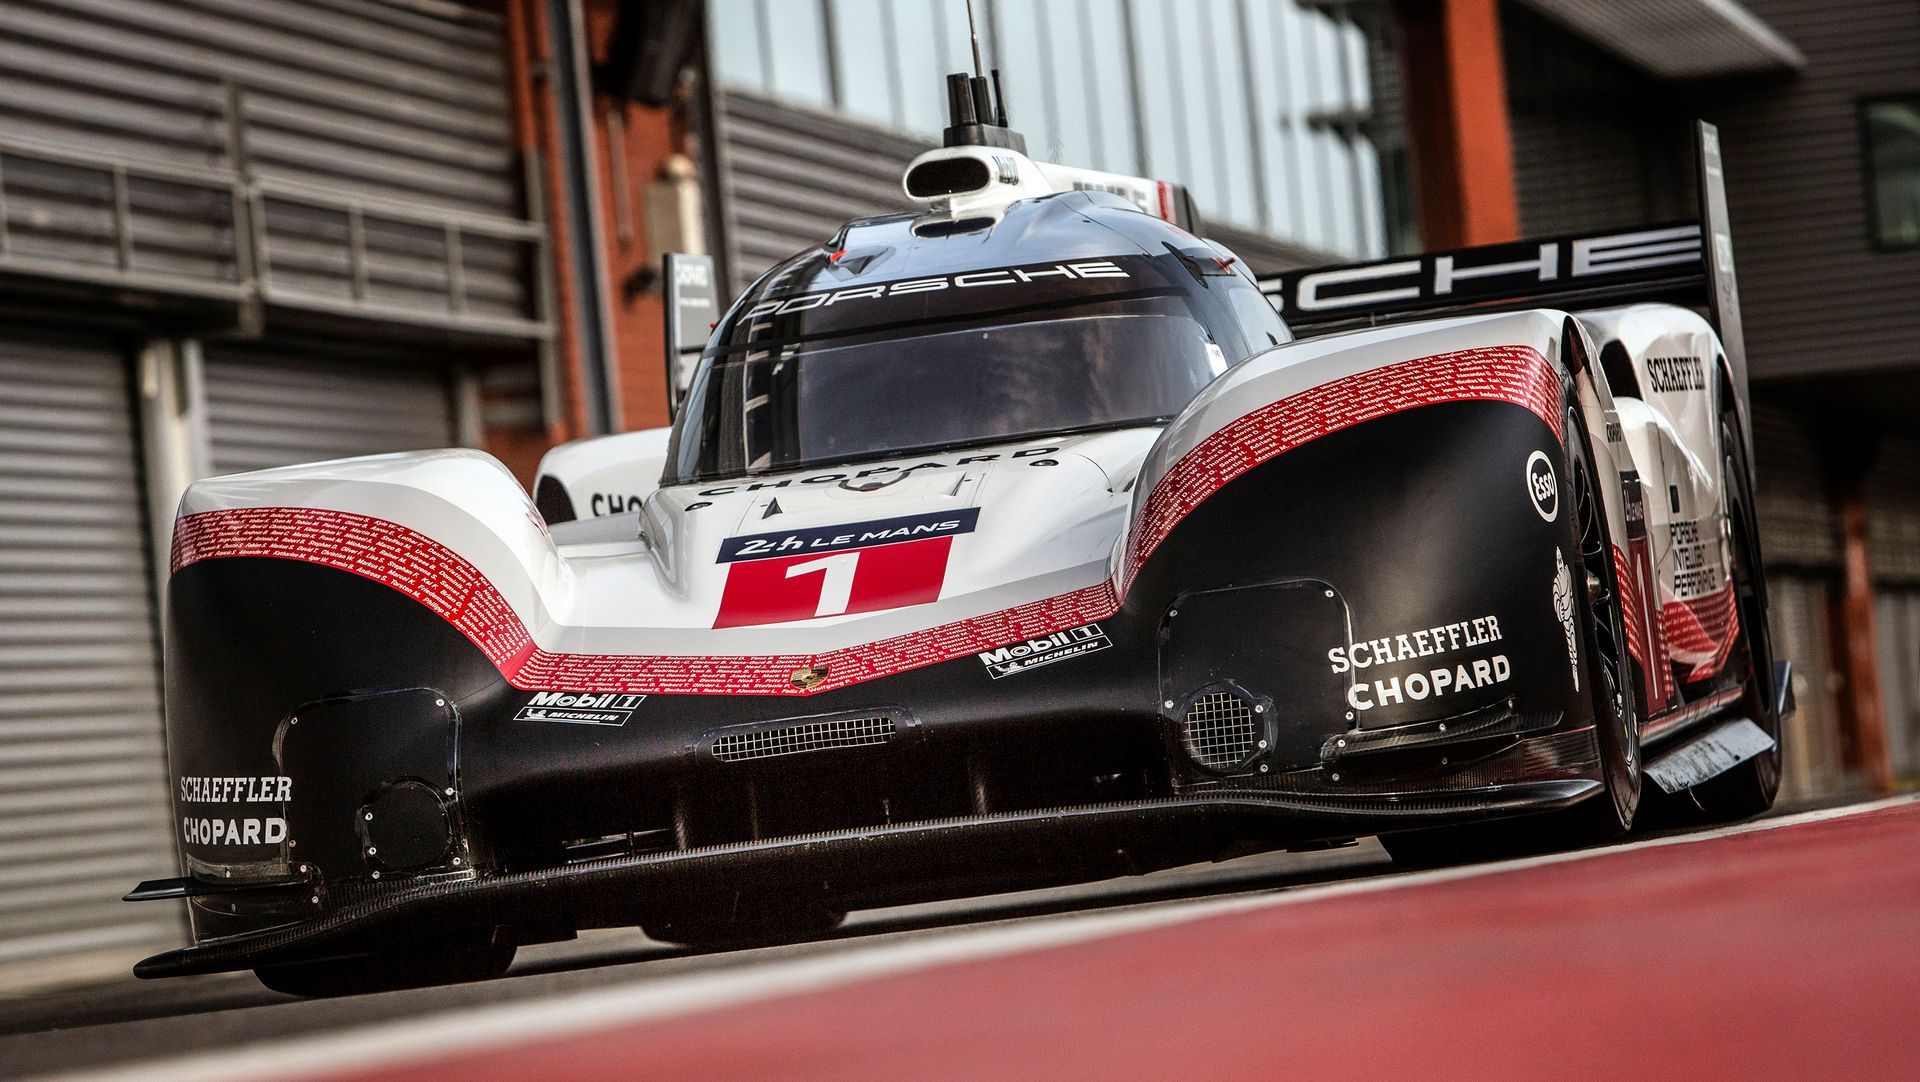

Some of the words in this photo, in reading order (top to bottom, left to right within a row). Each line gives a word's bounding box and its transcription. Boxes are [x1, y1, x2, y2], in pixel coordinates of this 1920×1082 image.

[736, 262, 1130, 326] PORSCHE
[698, 447, 1060, 496] CHOPARD
[1532, 472, 1555, 501] Esso
[810, 533, 855, 548] LE
[859, 519, 961, 542] MANS
[785, 551, 861, 617] 1
[978, 631, 1071, 666] Mobil
[1024, 641, 1099, 666] MICHELIN
[1328, 615, 1502, 674] SCHAEFFLER
[1347, 654, 1511, 710] CHOPARD
[527, 691, 617, 708] Mobil
[548, 711, 620, 721] MICHELIN
[180, 776, 293, 803] SCHAEFFLER
[183, 816, 288, 845] CHOPARD
